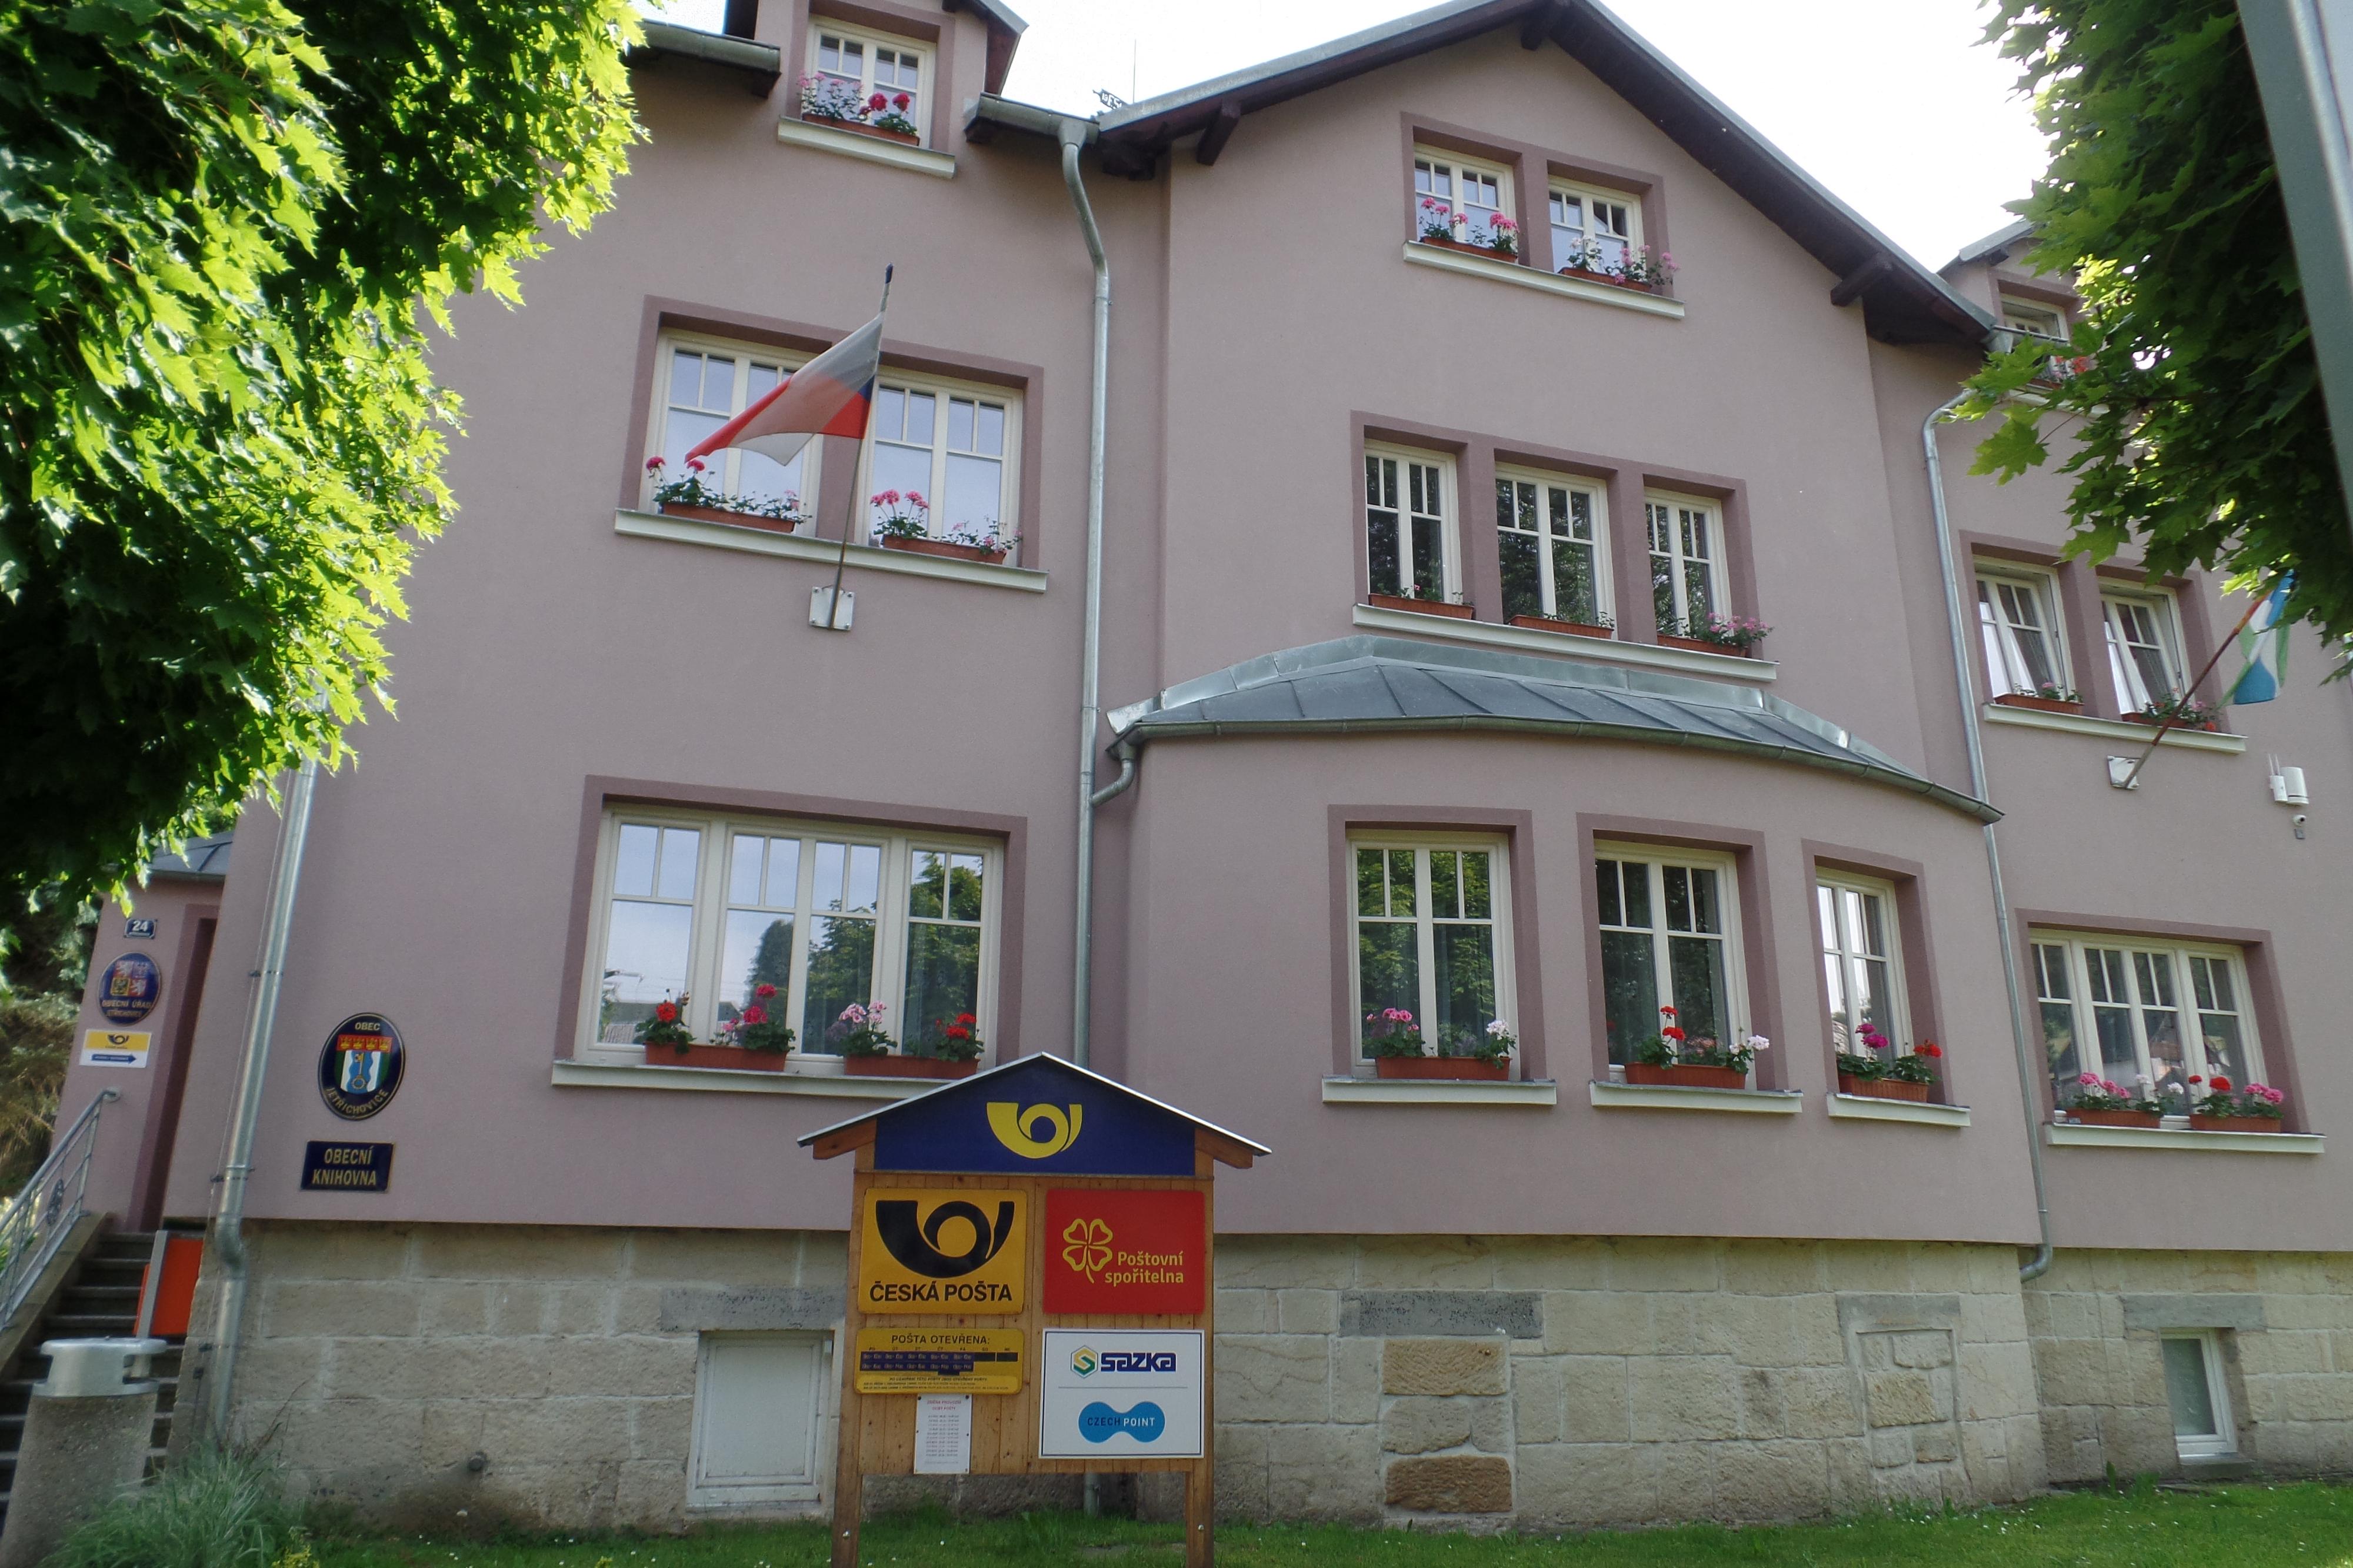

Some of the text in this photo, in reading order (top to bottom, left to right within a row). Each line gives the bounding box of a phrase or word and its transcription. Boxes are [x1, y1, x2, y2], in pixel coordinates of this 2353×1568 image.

[132, 920, 148, 932] 24
[355, 1022, 381, 1030] OBEC
[324, 1146, 374, 1165] OBECNÍ
[311, 1168, 377, 1186] KNIHOVNA
[1118, 1250, 1184, 1266] Poštovní
[1105, 1268, 1184, 1287] spořitelna
[869, 1280, 1012, 1302] ČESKÁ POŠTA
[892, 1333, 990, 1345] POŠTA OTEVŘENA:
[1088, 1417, 1155, 1426] CZECH POINT
